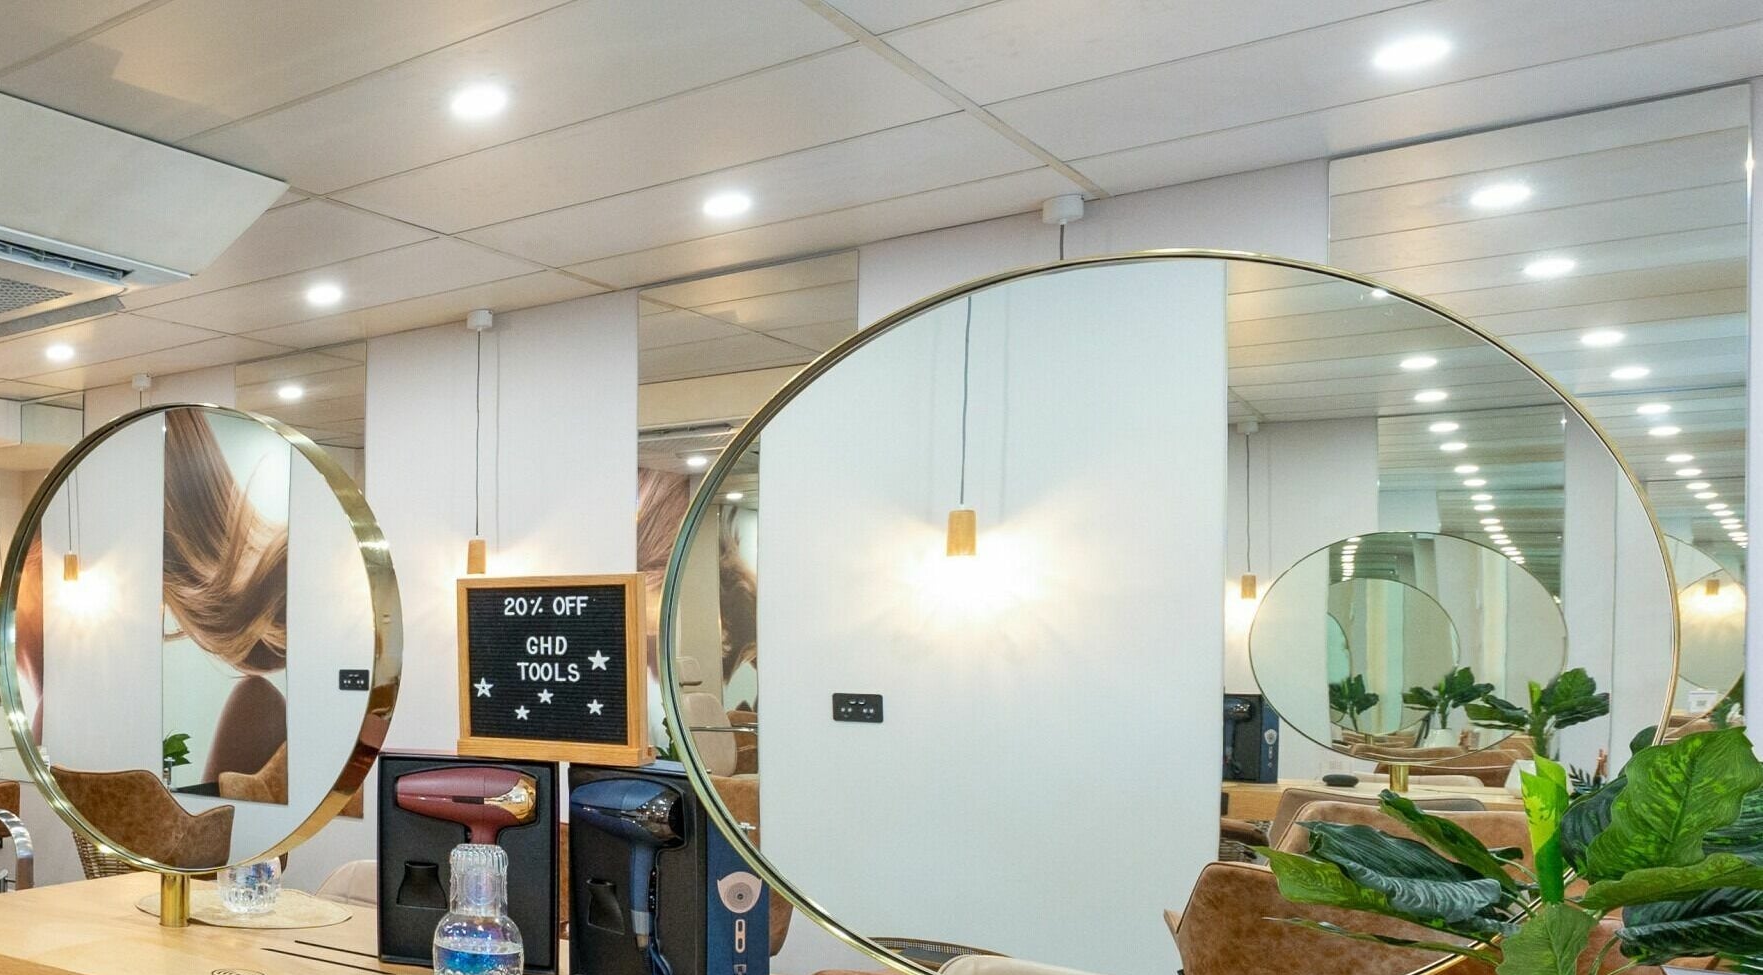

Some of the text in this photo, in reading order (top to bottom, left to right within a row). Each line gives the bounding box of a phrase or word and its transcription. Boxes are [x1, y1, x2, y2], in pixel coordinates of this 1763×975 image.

[504, 595, 589, 616] 20% OFF
[526, 636, 568, 656] GHD
[516, 662, 581, 682] TOOLS
